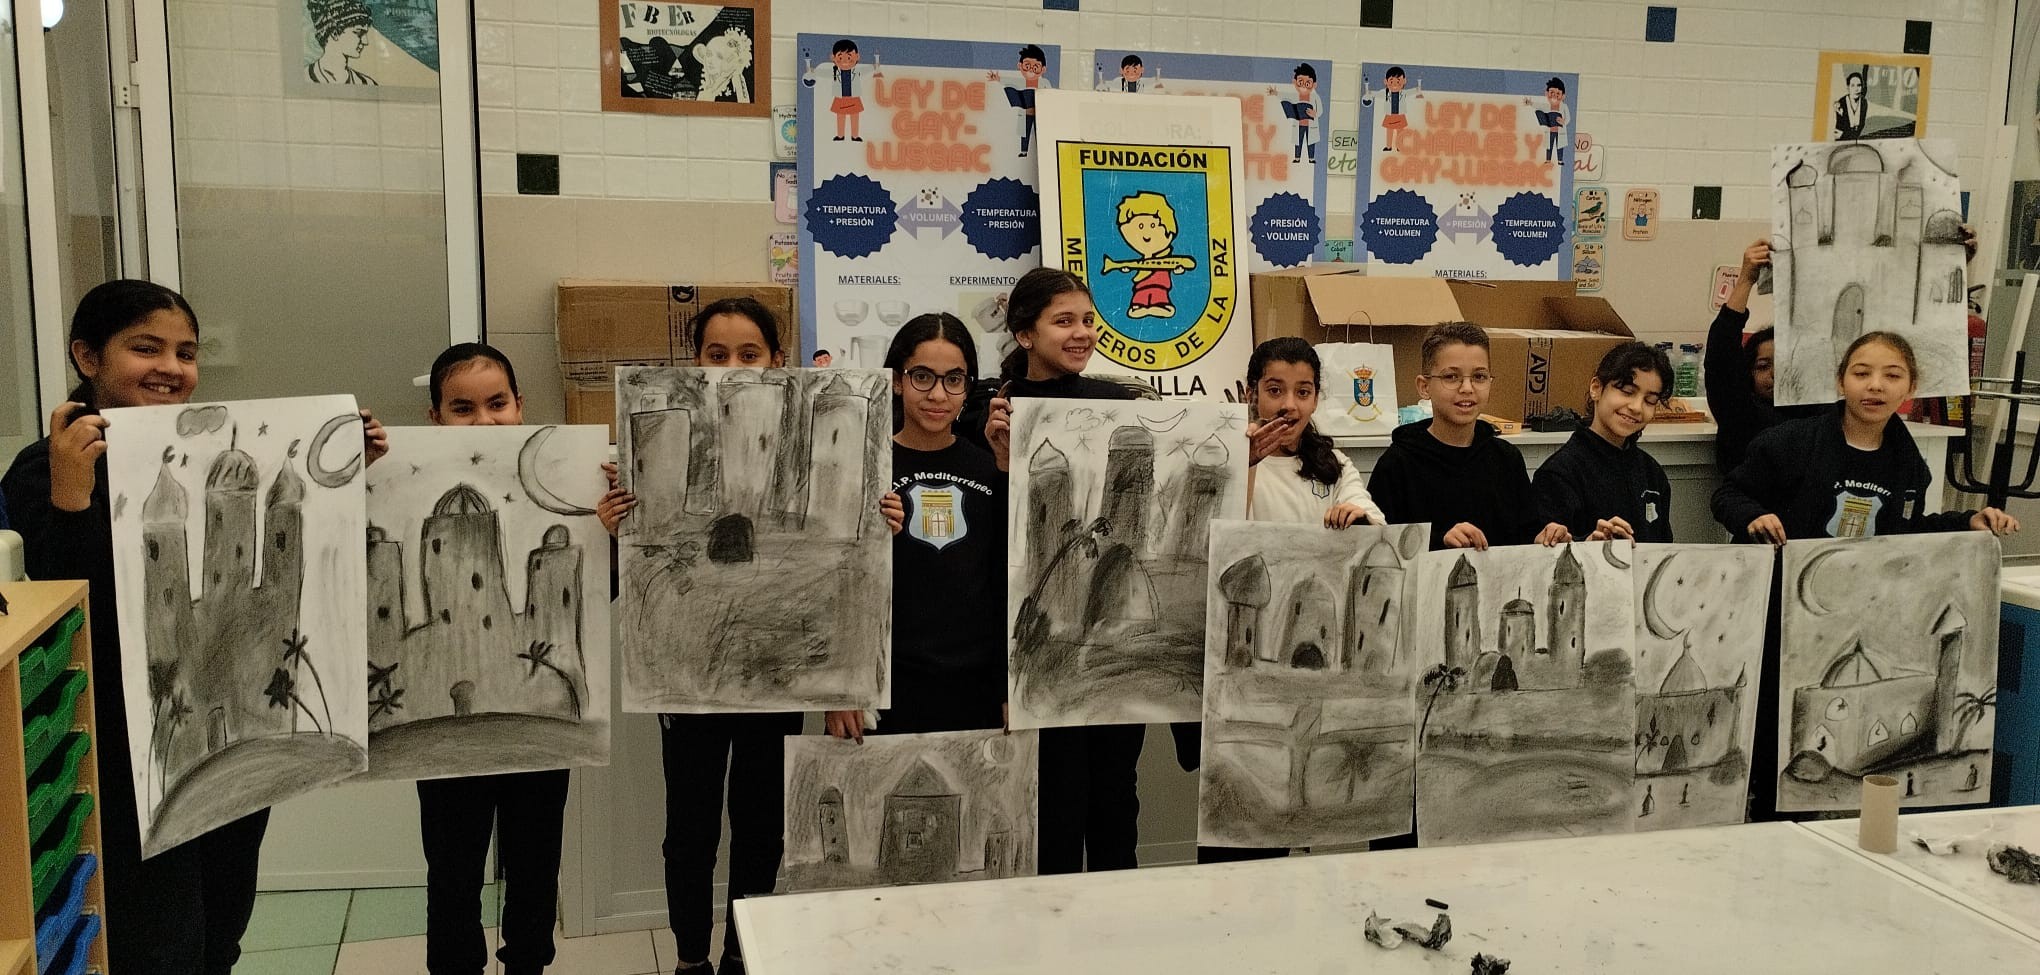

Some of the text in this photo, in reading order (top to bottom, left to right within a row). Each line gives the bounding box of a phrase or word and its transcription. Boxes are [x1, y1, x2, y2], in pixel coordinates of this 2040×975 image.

[875, 78, 985, 111] LEY DE
[1425, 101, 1517, 131] LEY DE
[892, 110, 977, 141] GAY-
[1524, 133, 1543, 160] Y
[1080, 149, 1207, 168] FUNDACIÓN
[823, 205, 887, 215] TEMPERATURA
[976, 208, 1037, 217] TEMPERATURA
[836, 217, 874, 226] PRESIÓN
[910, 213, 957, 222] VOLUMEN
[1271, 217, 1308, 228] PRESIÓN
[1376, 217, 1430, 226] TEMPERATURA
[988, 219, 1025, 229] PRESIÓN
[1452, 219, 1487, 229] PRESIÓN
[1505, 219, 1556, 228] TEMPERATURA
[1266, 232, 1310, 241] VOLUMEN
[1384, 229, 1421, 237] VOLUMEN
[1512, 230, 1548, 238] VOLUMEN
[1213, 237, 1229, 277] PAZ
[1435, 269, 1487, 278] MATERIALES:
[838, 275, 901, 285] MATERIALES:
[949, 276, 1018, 285] EXPERIMENTO:
[1207, 296, 1228, 324] LA
[1175, 331, 1205, 358] DE
[914, 471, 993, 496] Mediterráneo
